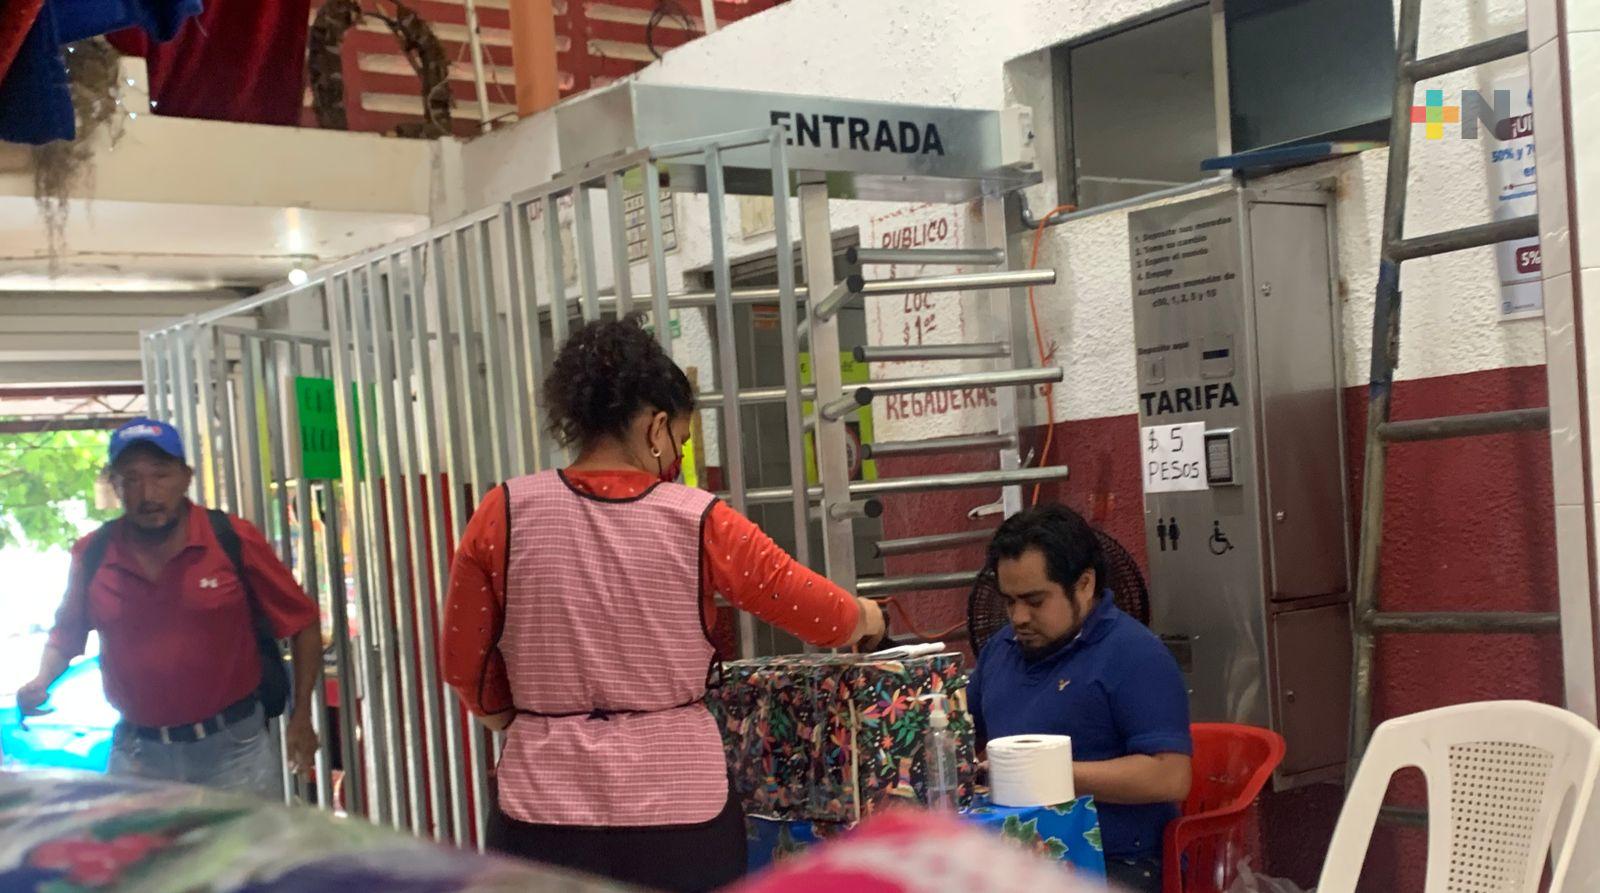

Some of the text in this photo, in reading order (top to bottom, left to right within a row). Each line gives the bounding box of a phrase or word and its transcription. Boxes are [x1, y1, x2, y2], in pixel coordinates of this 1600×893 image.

[770, 110, 945, 156] ENTRADA
[882, 218, 948, 248] PUBLICO
[1195, 216, 1232, 230] monedas
[1178, 235, 1207, 247] cambio
[1183, 274, 1222, 288] monedas
[1140, 382, 1240, 416] TARIFA
[1170, 427, 1184, 452] 5
